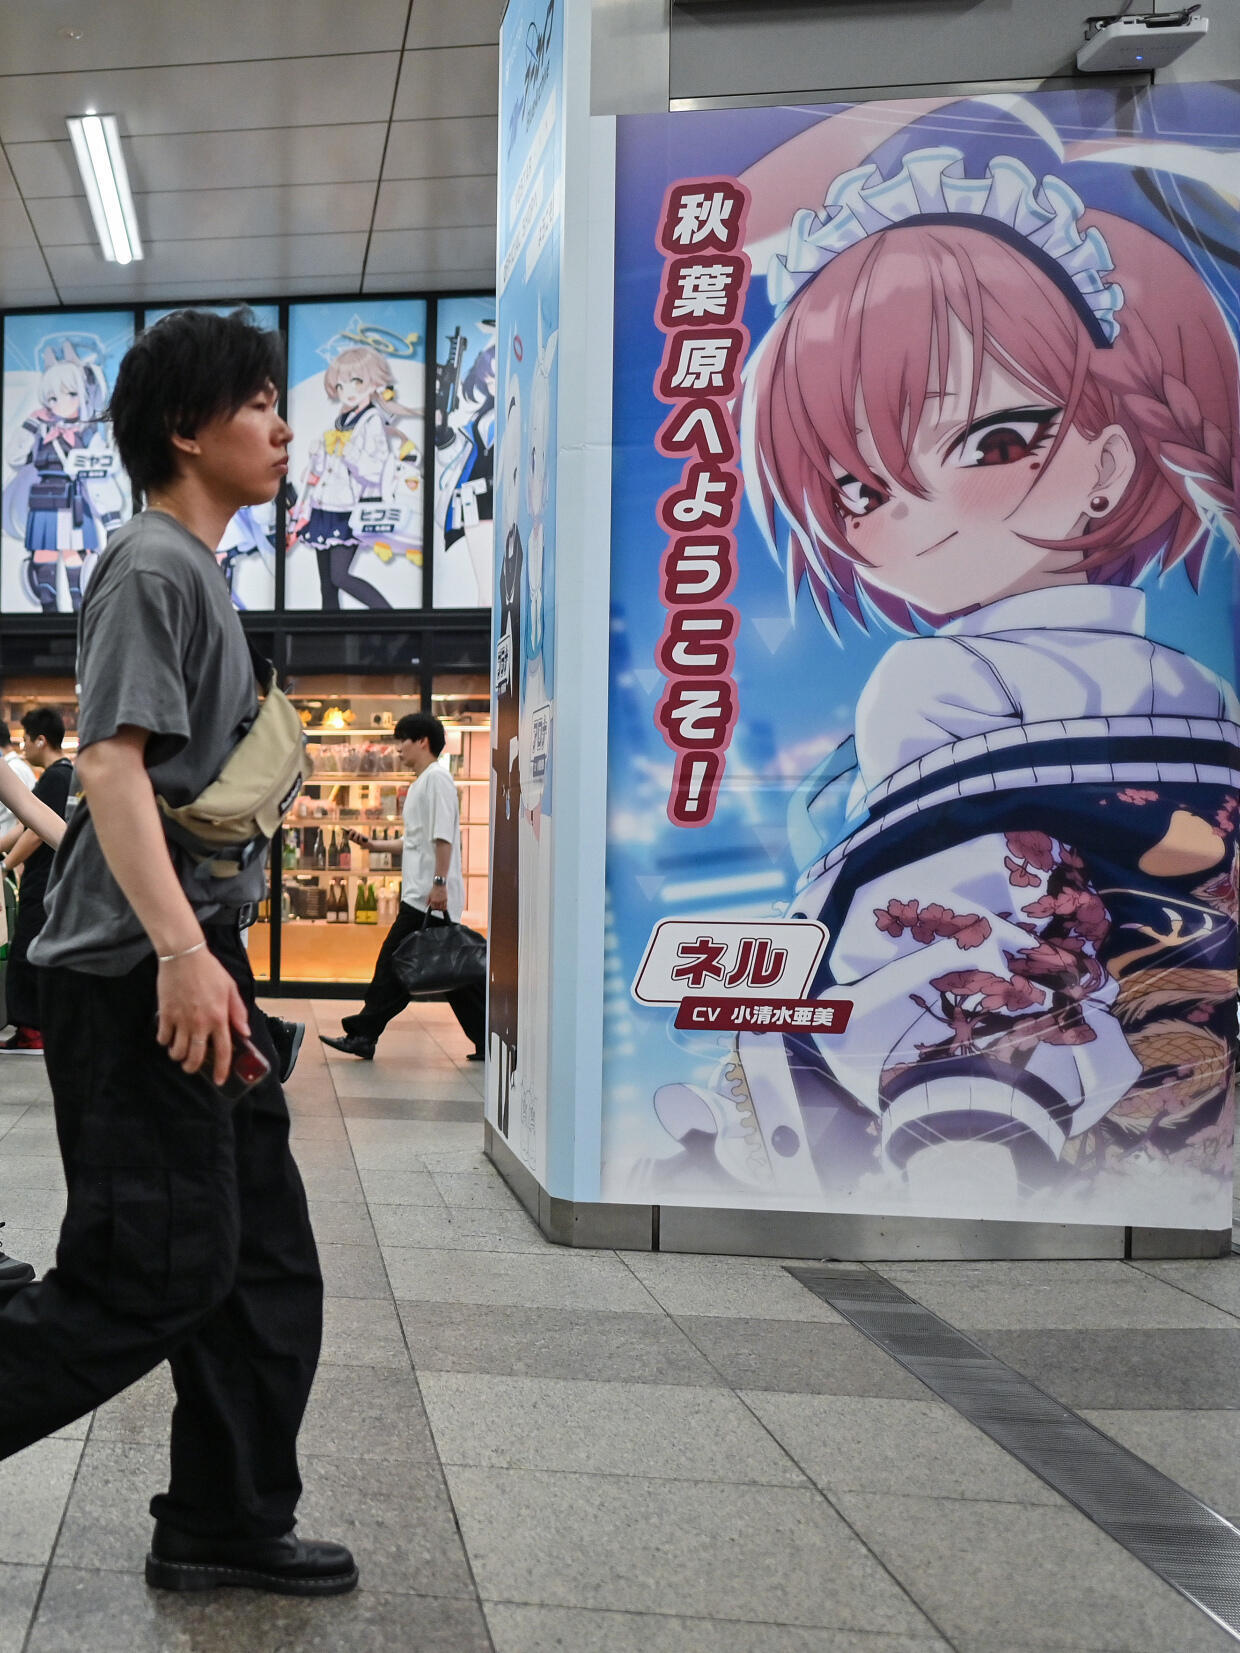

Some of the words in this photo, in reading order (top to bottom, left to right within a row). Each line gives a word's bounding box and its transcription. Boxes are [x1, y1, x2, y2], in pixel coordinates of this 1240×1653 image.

[73, 454, 114, 468] ミヤコ
[672, 937, 788, 988] ネル
[692, 1006, 722, 1023] CV
[730, 1004, 836, 1027] 小清水亜美
